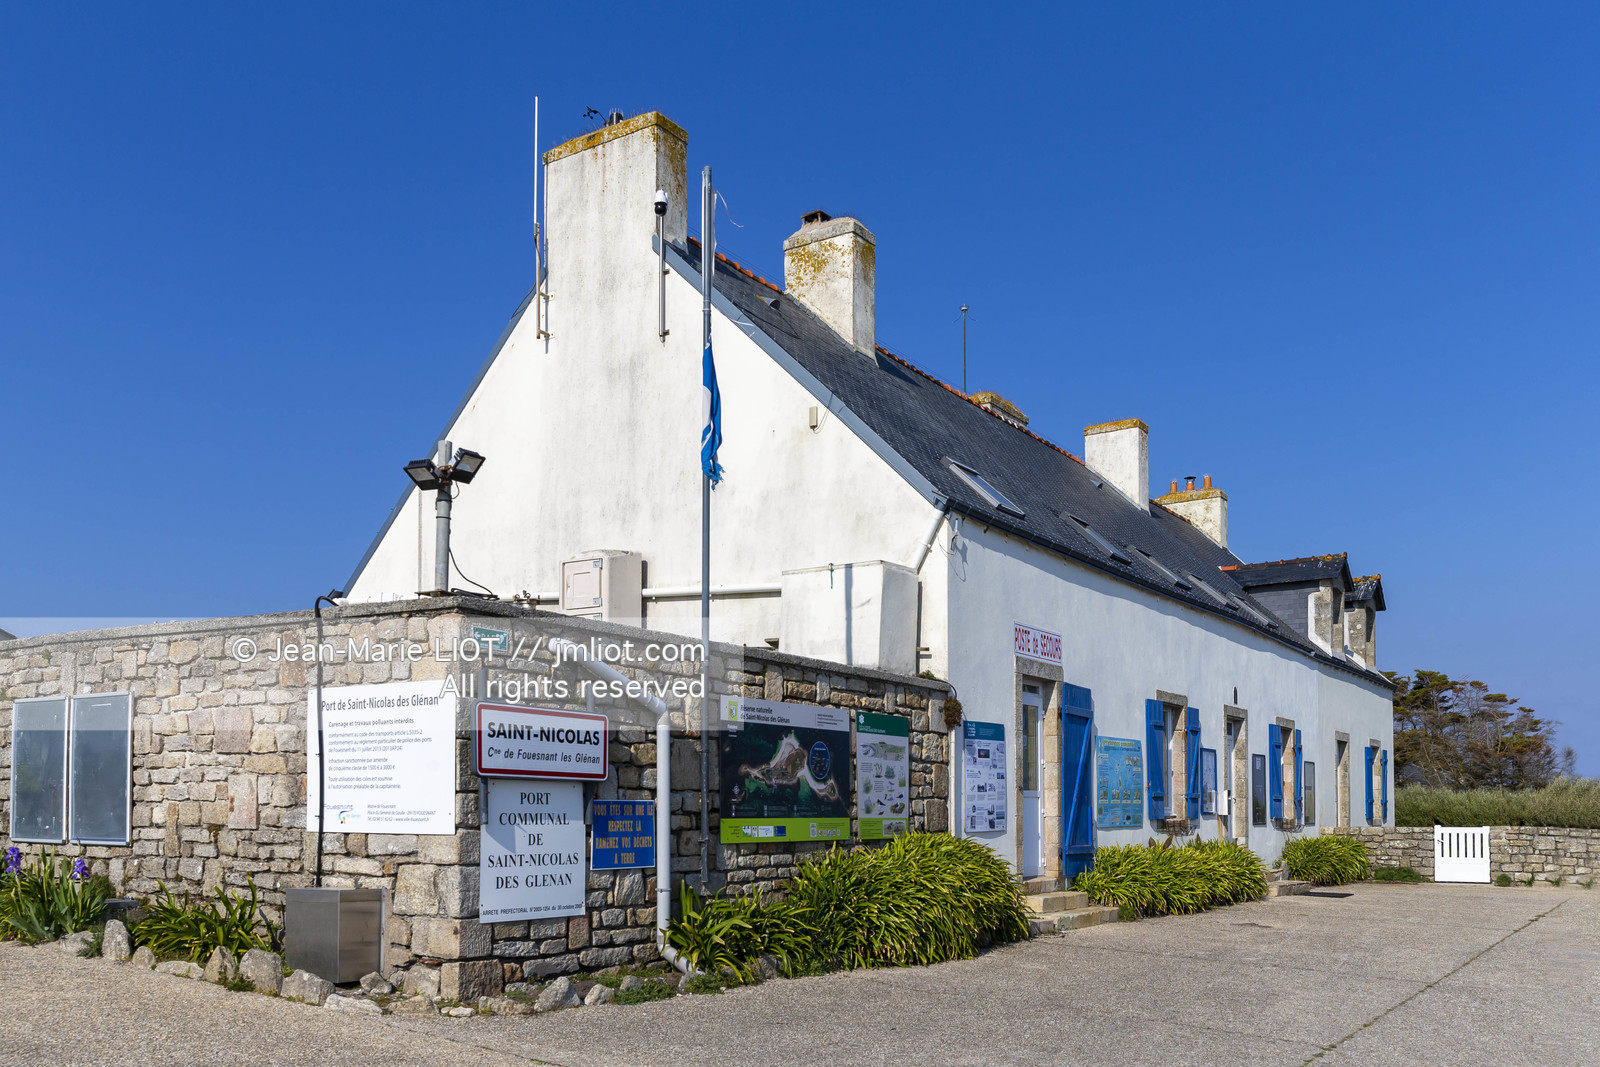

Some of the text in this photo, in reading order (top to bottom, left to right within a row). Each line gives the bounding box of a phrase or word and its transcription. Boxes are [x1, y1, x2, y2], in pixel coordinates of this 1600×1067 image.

[1015, 628, 1061, 660] POSTE de SECOURS
[322, 694, 439, 711] Port de Saint-Nicolas des Glénan
[488, 722, 600, 745] SAINT-NICOLAS
[504, 748, 514, 759] de
[517, 749, 557, 761] Fouesnant
[561, 752, 571, 762] les
[575, 753, 600, 764] Glénan
[520, 792, 551, 805] PORT
[594, 804, 606, 816] VOUS
[610, 802, 620, 816] ÊTES
[624, 805, 632, 815] SUR
[636, 805, 644, 815] UNE
[500, 813, 569, 825] COMMUNAL
[608, 820, 641, 832] RESPECTEZ LA
[528, 834, 543, 846] DE
[595, 834, 652, 849] RAMENEZ VOS DÉCHETS
[488, 852, 579, 868] SAINT-NICOLAS
[614, 852, 635, 864] A TERRE
[496, 873, 572, 889] DES GLENAN
